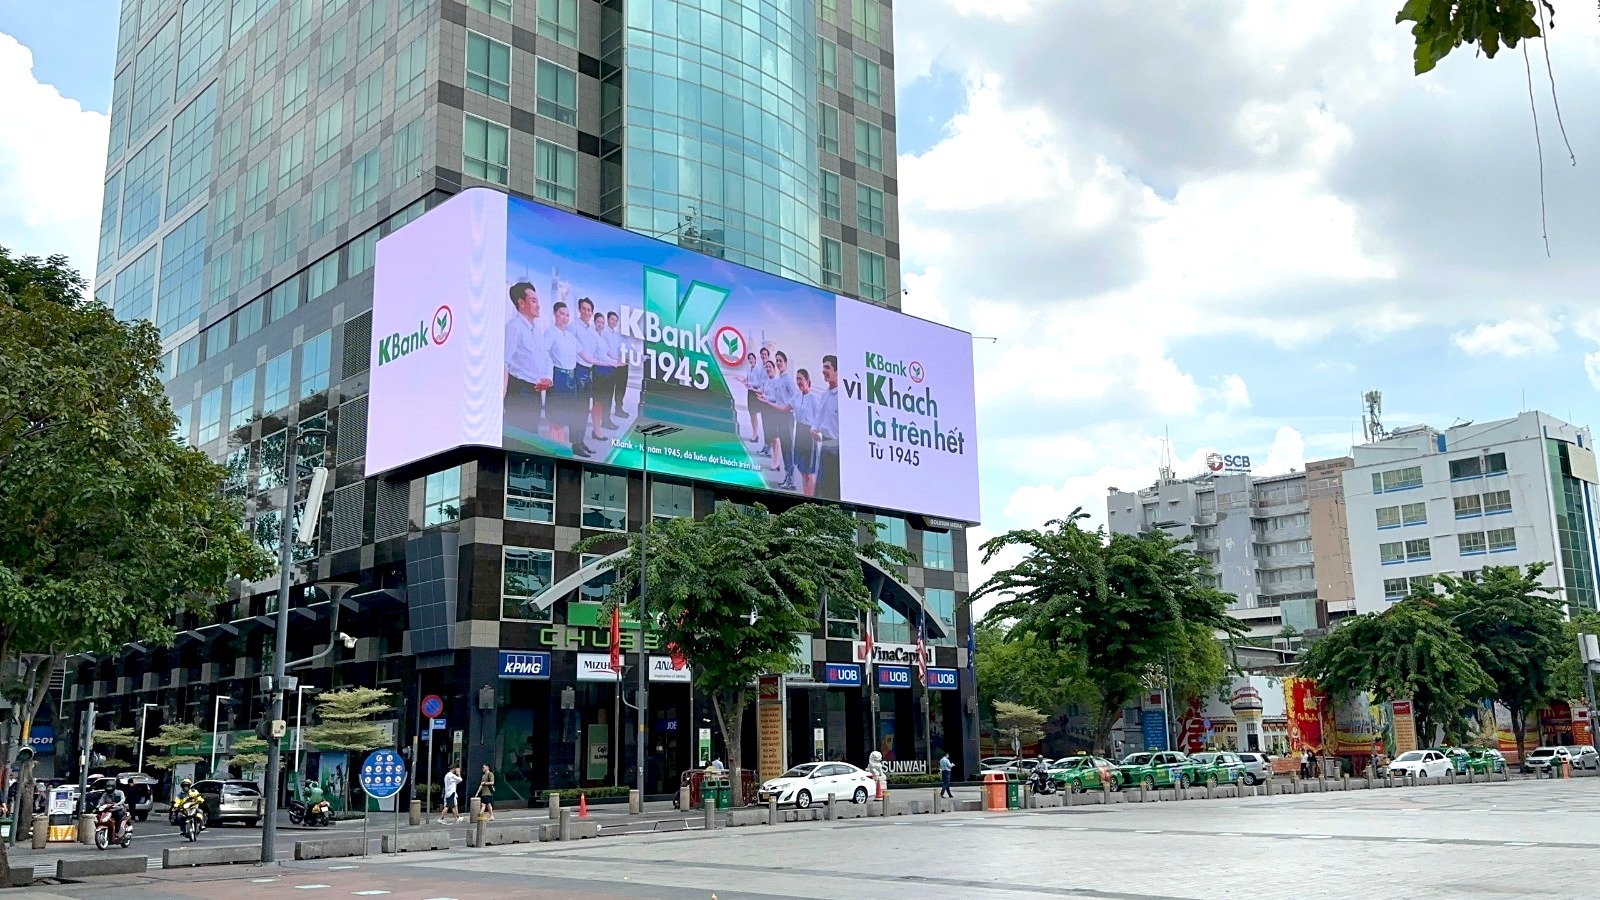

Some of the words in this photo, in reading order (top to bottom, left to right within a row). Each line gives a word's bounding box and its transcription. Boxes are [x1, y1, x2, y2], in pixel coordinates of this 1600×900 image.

[620, 304, 710, 355] KBank
[379, 320, 429, 366] KBank
[646, 348, 709, 390] 1945
[866, 351, 908, 377] KBank
[843, 373, 862, 400] vì
[866, 371, 938, 418] Khách
[868, 406, 887, 439] là
[891, 417, 932, 449] trên
[934, 420, 965, 455] hết
[611, 438, 633, 450] KBank
[889, 445, 920, 467] 1945
[1224, 455, 1250, 467] SCB
[871, 646, 932, 664] VinaCapial
[504, 662, 541, 674] KPMG
[584, 660, 612, 670] MIZUH
[838, 669, 858, 681] UOB
[890, 671, 908, 682] UOB
[937, 672, 955, 684] UOB
[882, 760, 926, 773] SUNWAH
